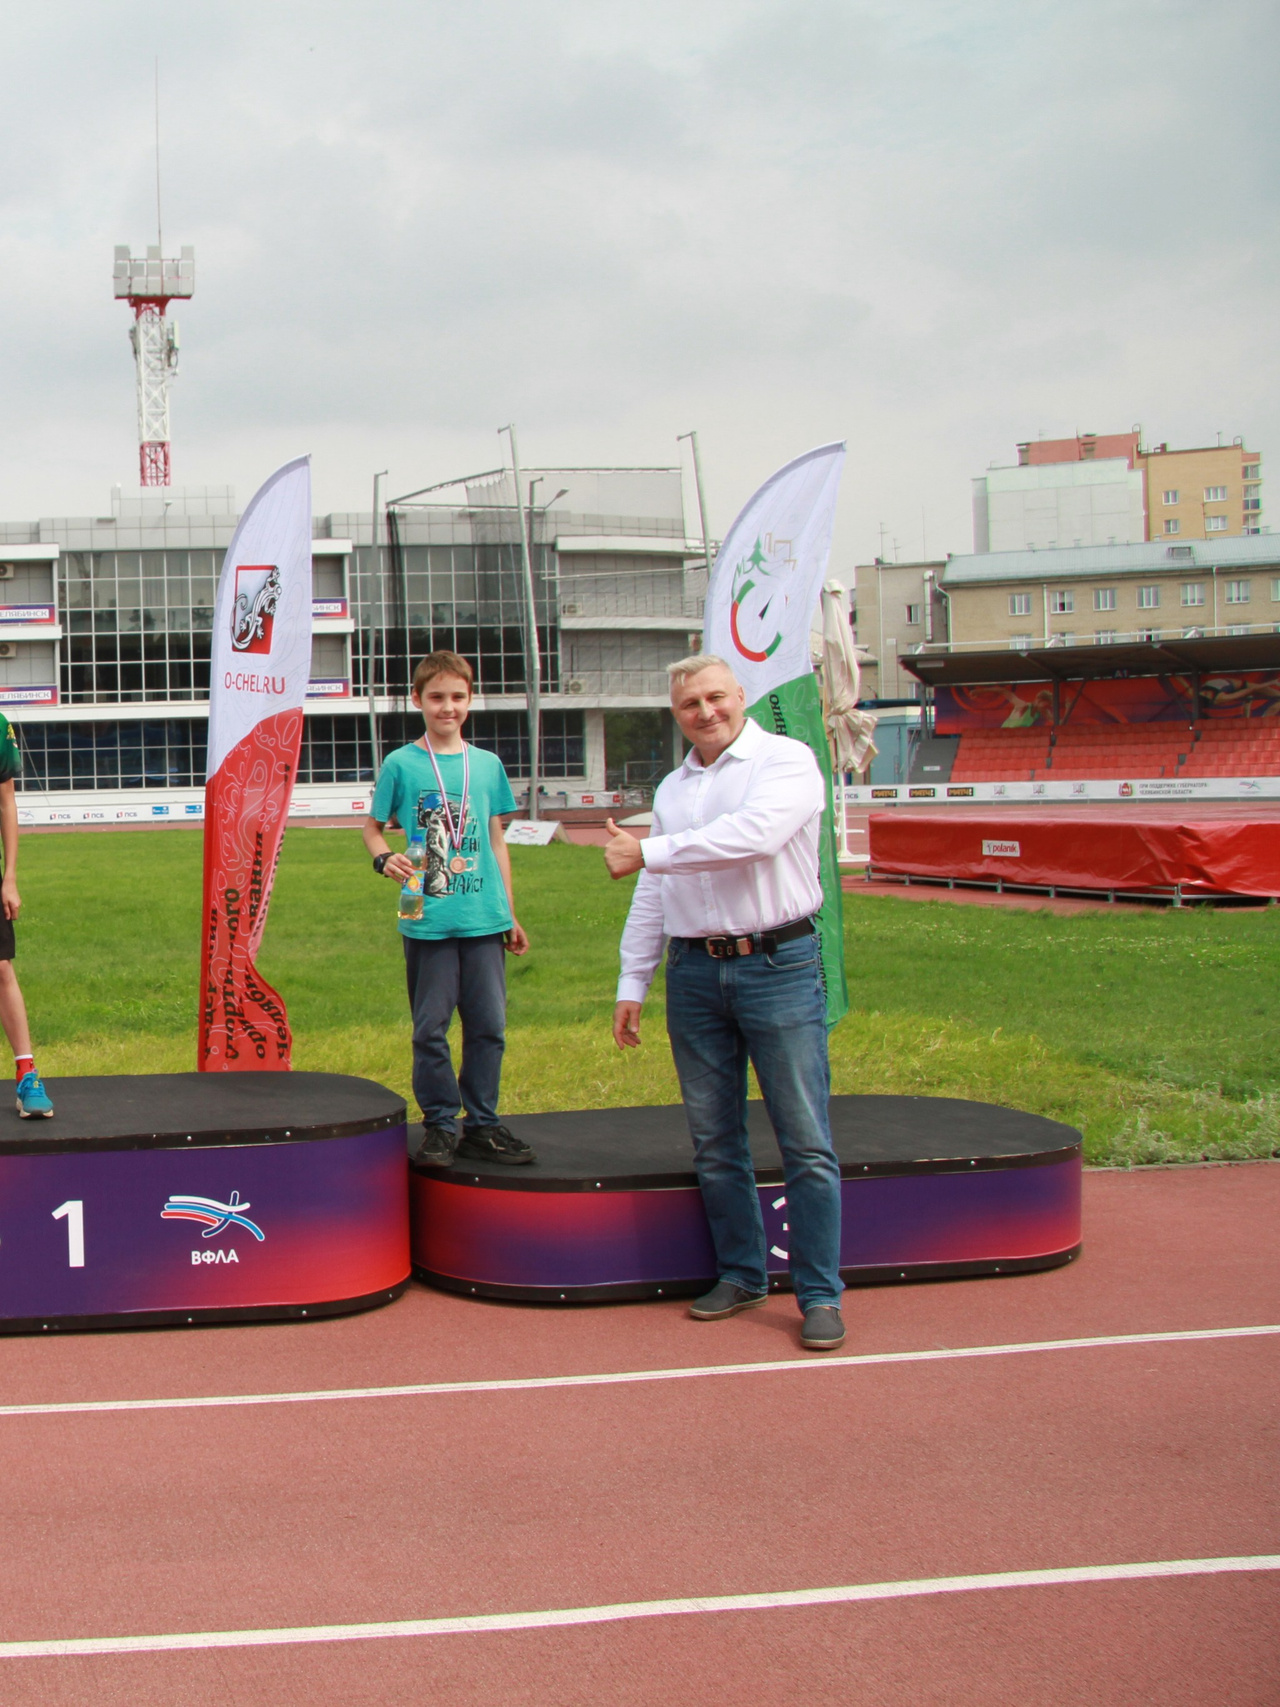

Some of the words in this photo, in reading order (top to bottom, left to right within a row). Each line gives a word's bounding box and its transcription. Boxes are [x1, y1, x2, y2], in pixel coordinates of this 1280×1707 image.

[992, 843, 1017, 854] polanik
[446, 873, 484, 895] НАЙС!
[51, 1200, 85, 1268] 1
[191, 1249, 239, 1265] ВФЛА
